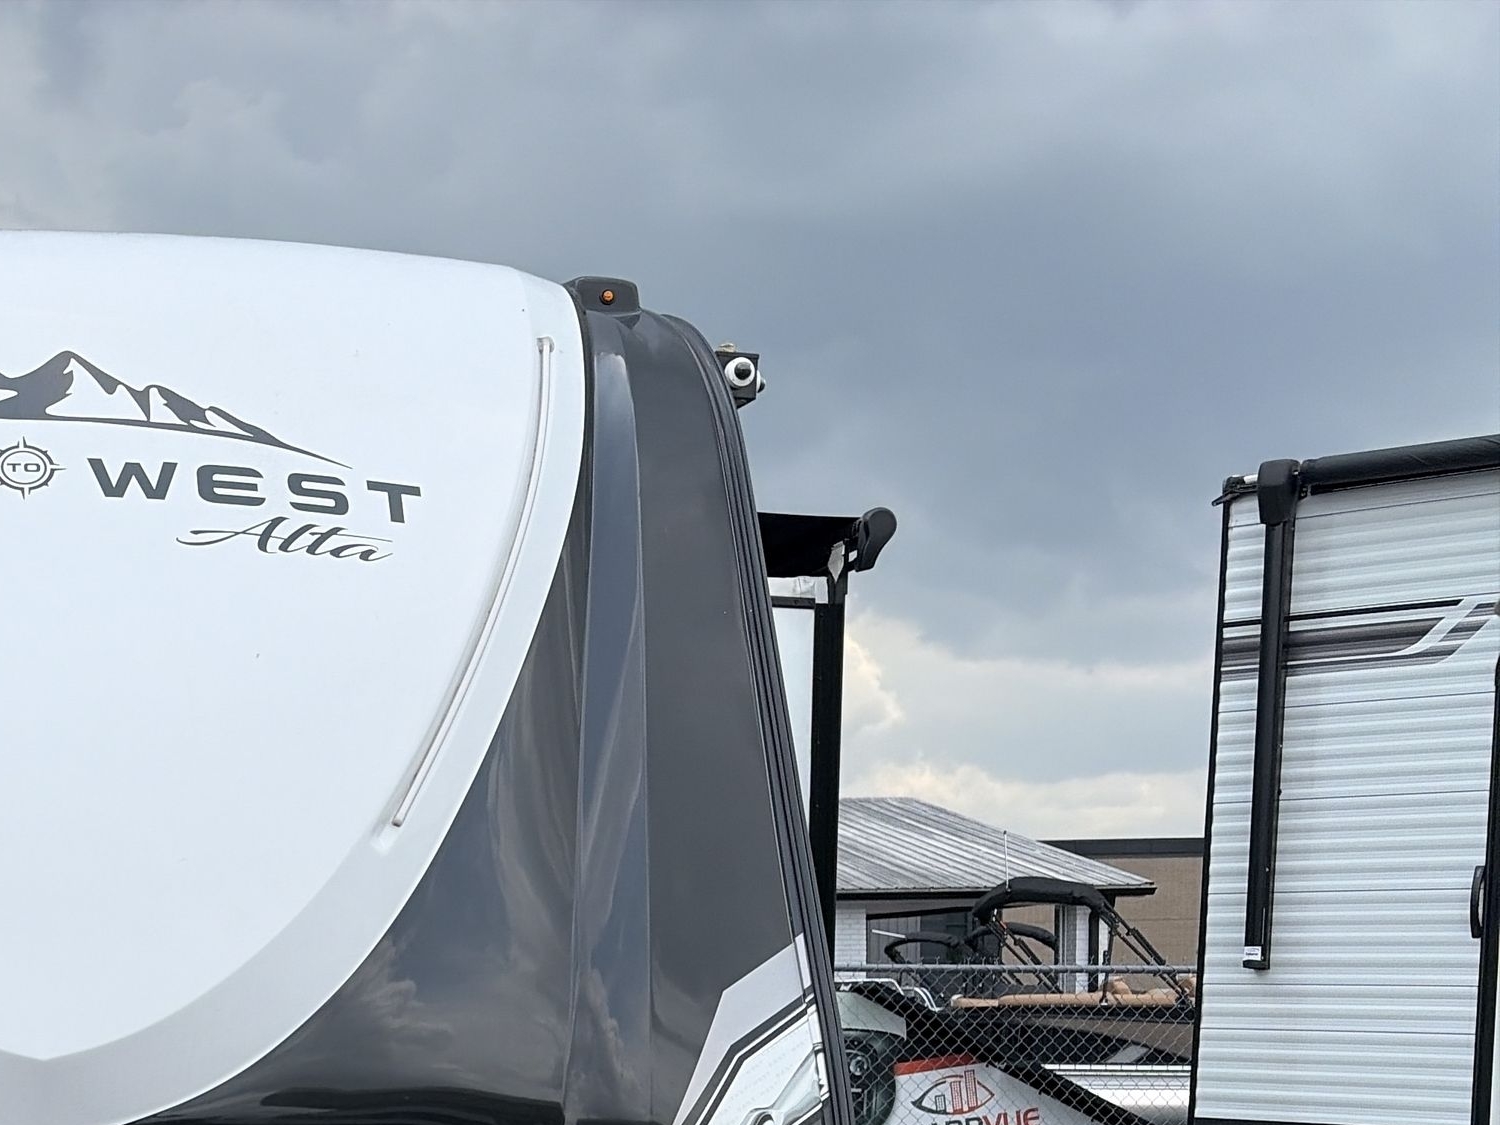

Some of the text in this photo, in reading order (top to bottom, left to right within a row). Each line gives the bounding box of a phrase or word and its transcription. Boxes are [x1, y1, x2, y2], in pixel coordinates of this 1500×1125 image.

[7, 462, 41, 473] TO
[86, 458, 422, 524] WEST
[176, 516, 393, 562] Alta
